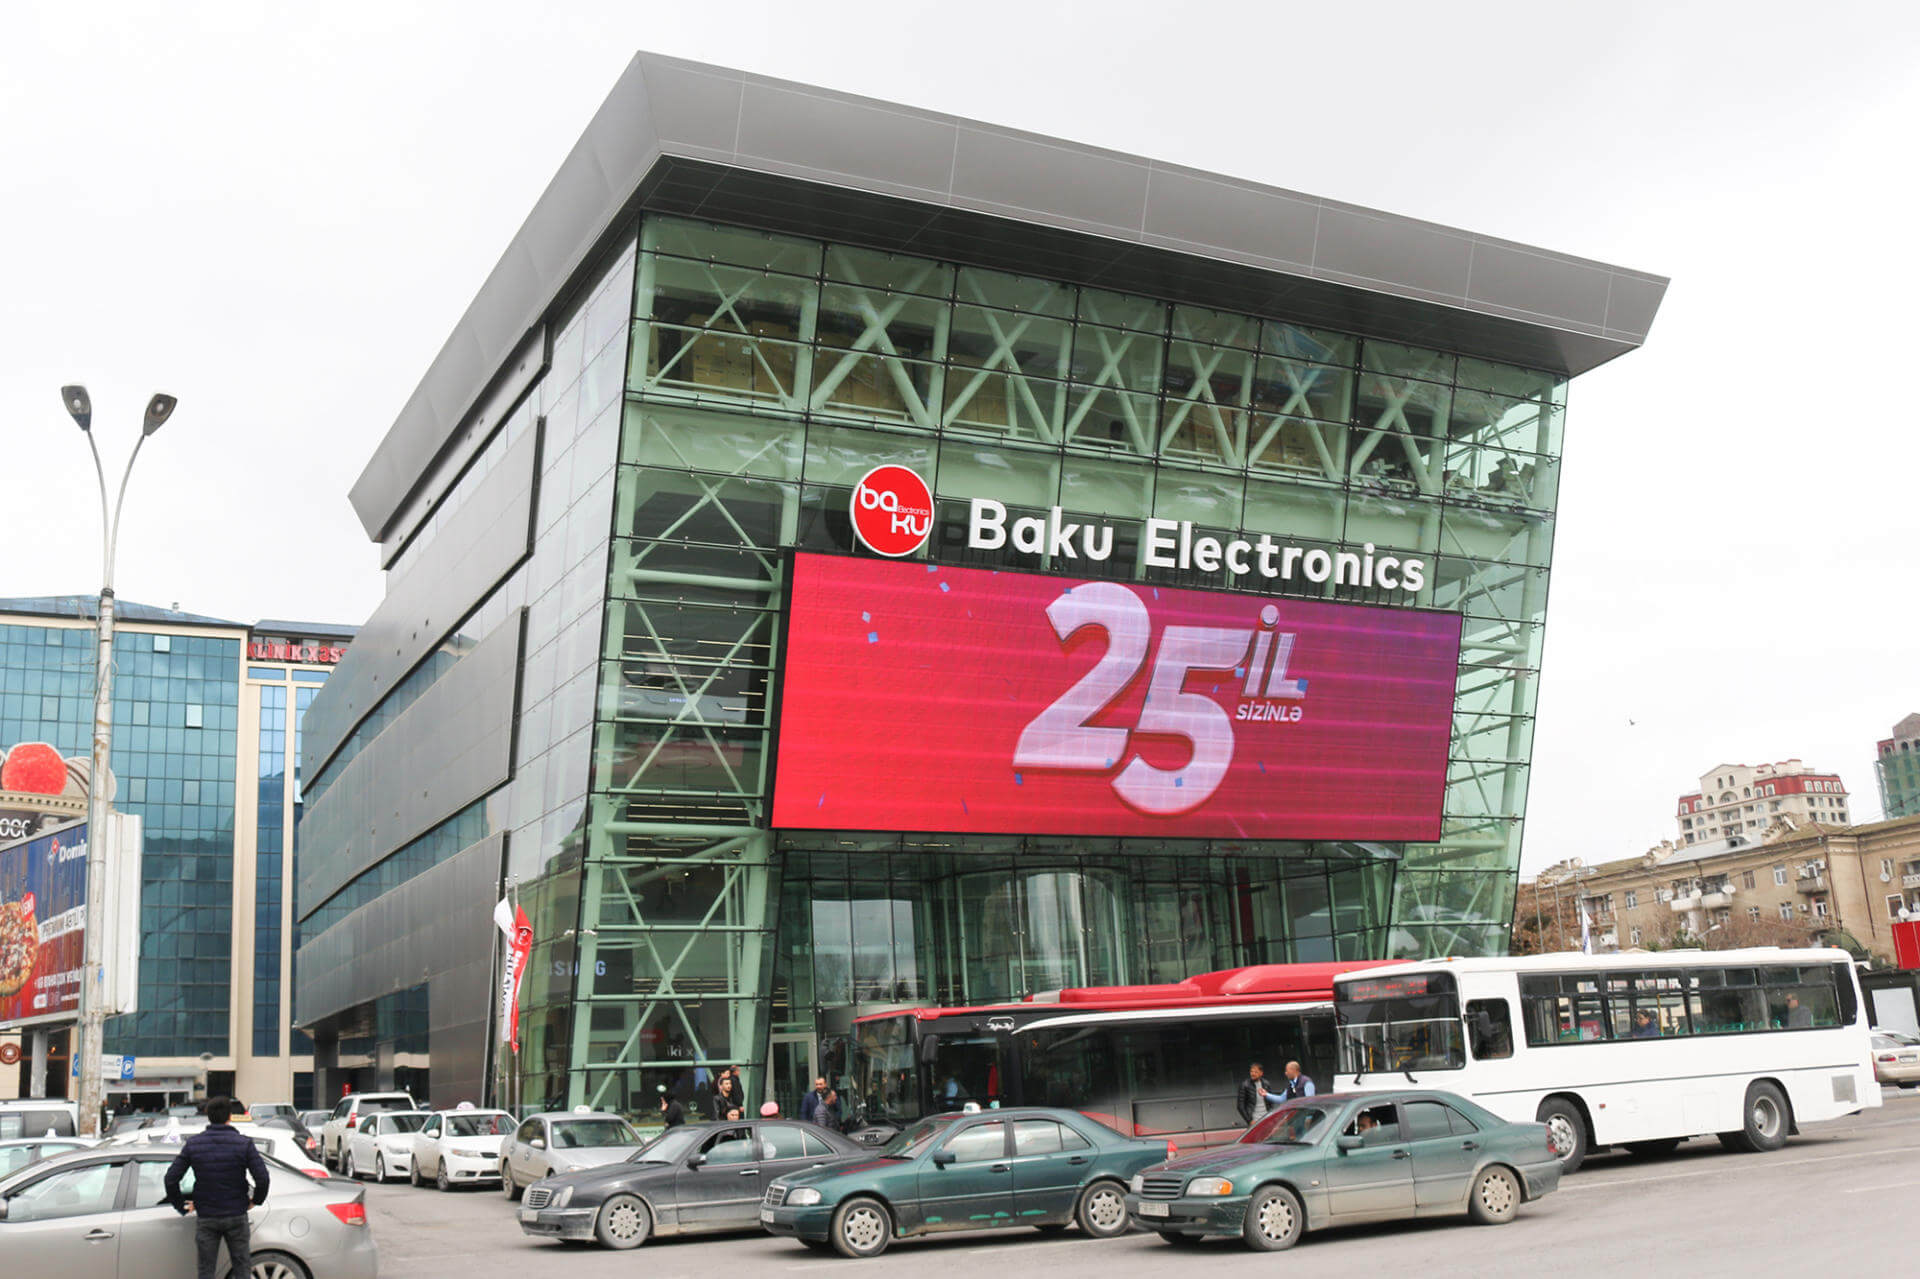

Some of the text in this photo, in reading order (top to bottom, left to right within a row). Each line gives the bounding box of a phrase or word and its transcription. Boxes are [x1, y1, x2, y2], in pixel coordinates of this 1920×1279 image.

[967, 498, 1427, 593] Baku Electronics
[1012, 580, 1309, 815] 25 İL
[1235, 700, 1303, 722] SİZİNLƏ
